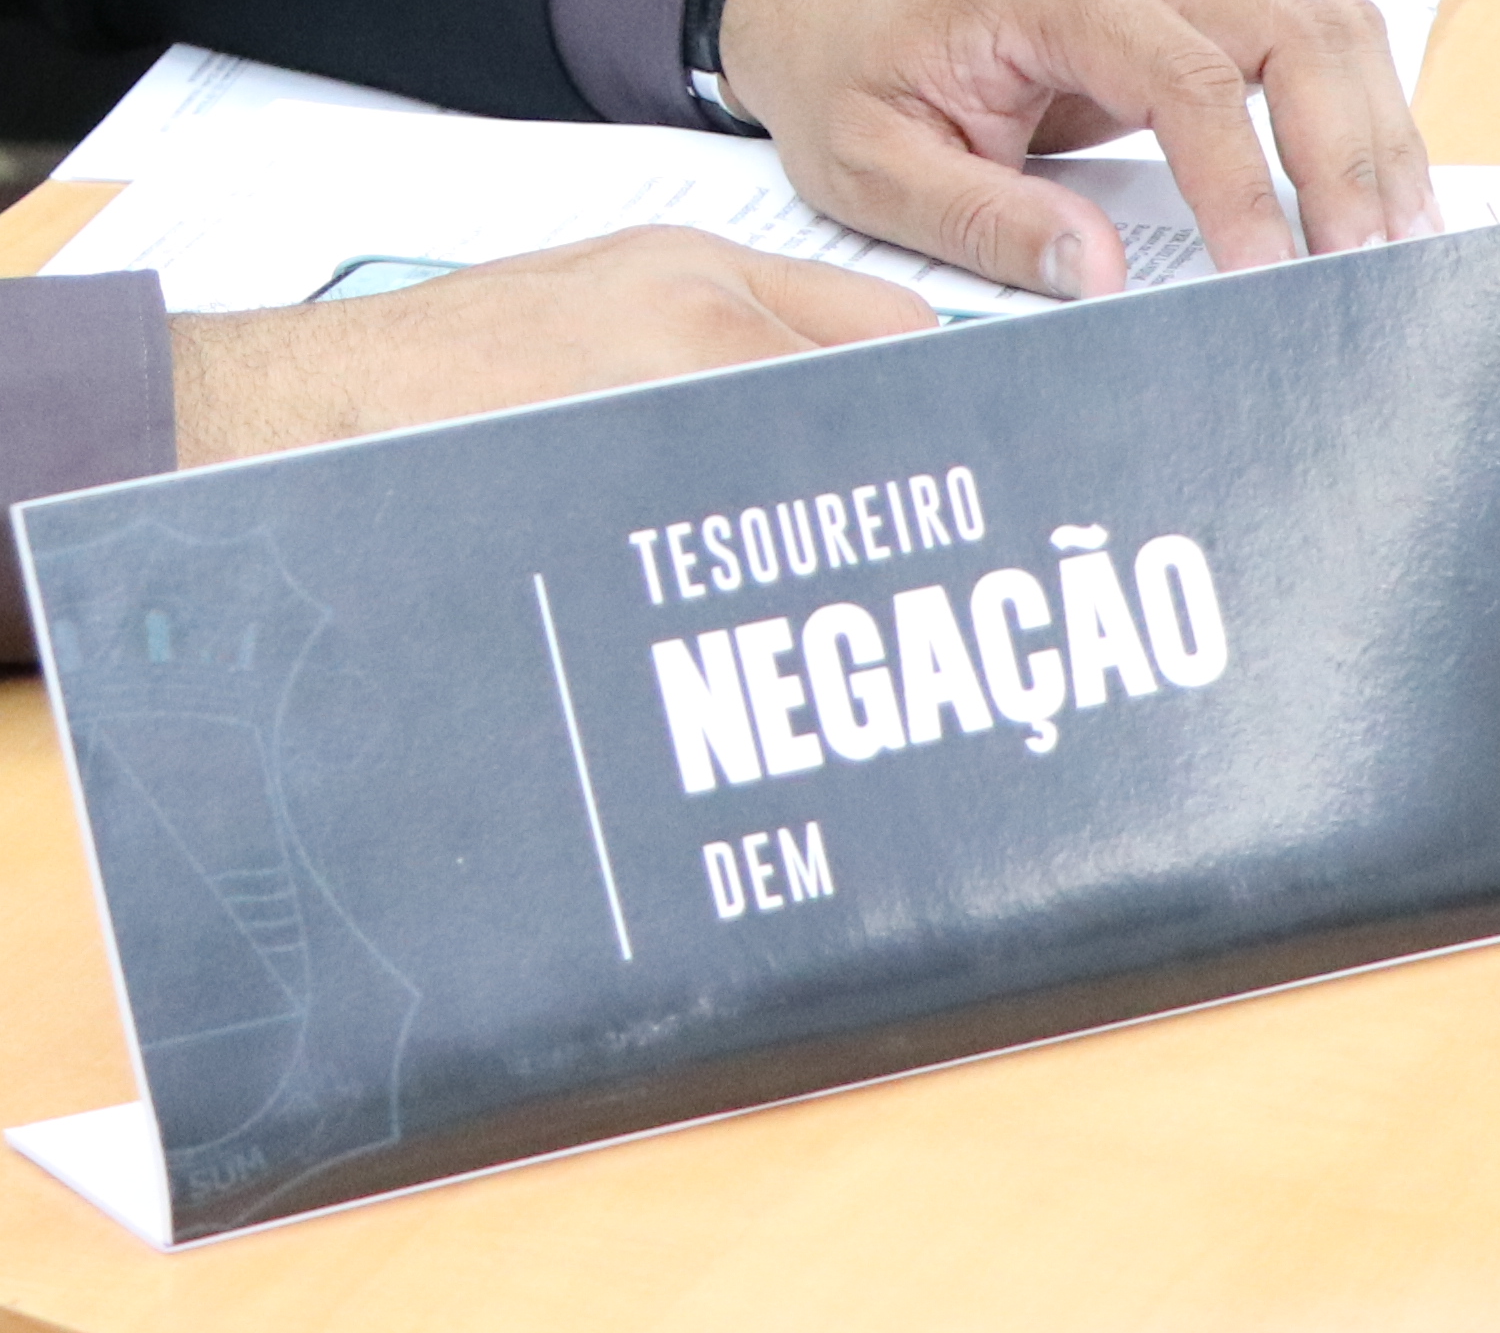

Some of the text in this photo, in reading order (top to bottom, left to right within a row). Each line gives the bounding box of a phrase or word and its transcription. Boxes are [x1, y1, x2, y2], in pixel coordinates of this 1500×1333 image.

[628, 465, 986, 605] TESOUREIRO
[650, 522, 1229, 795] NEGAÇÃO
[702, 821, 834, 920] DEM
